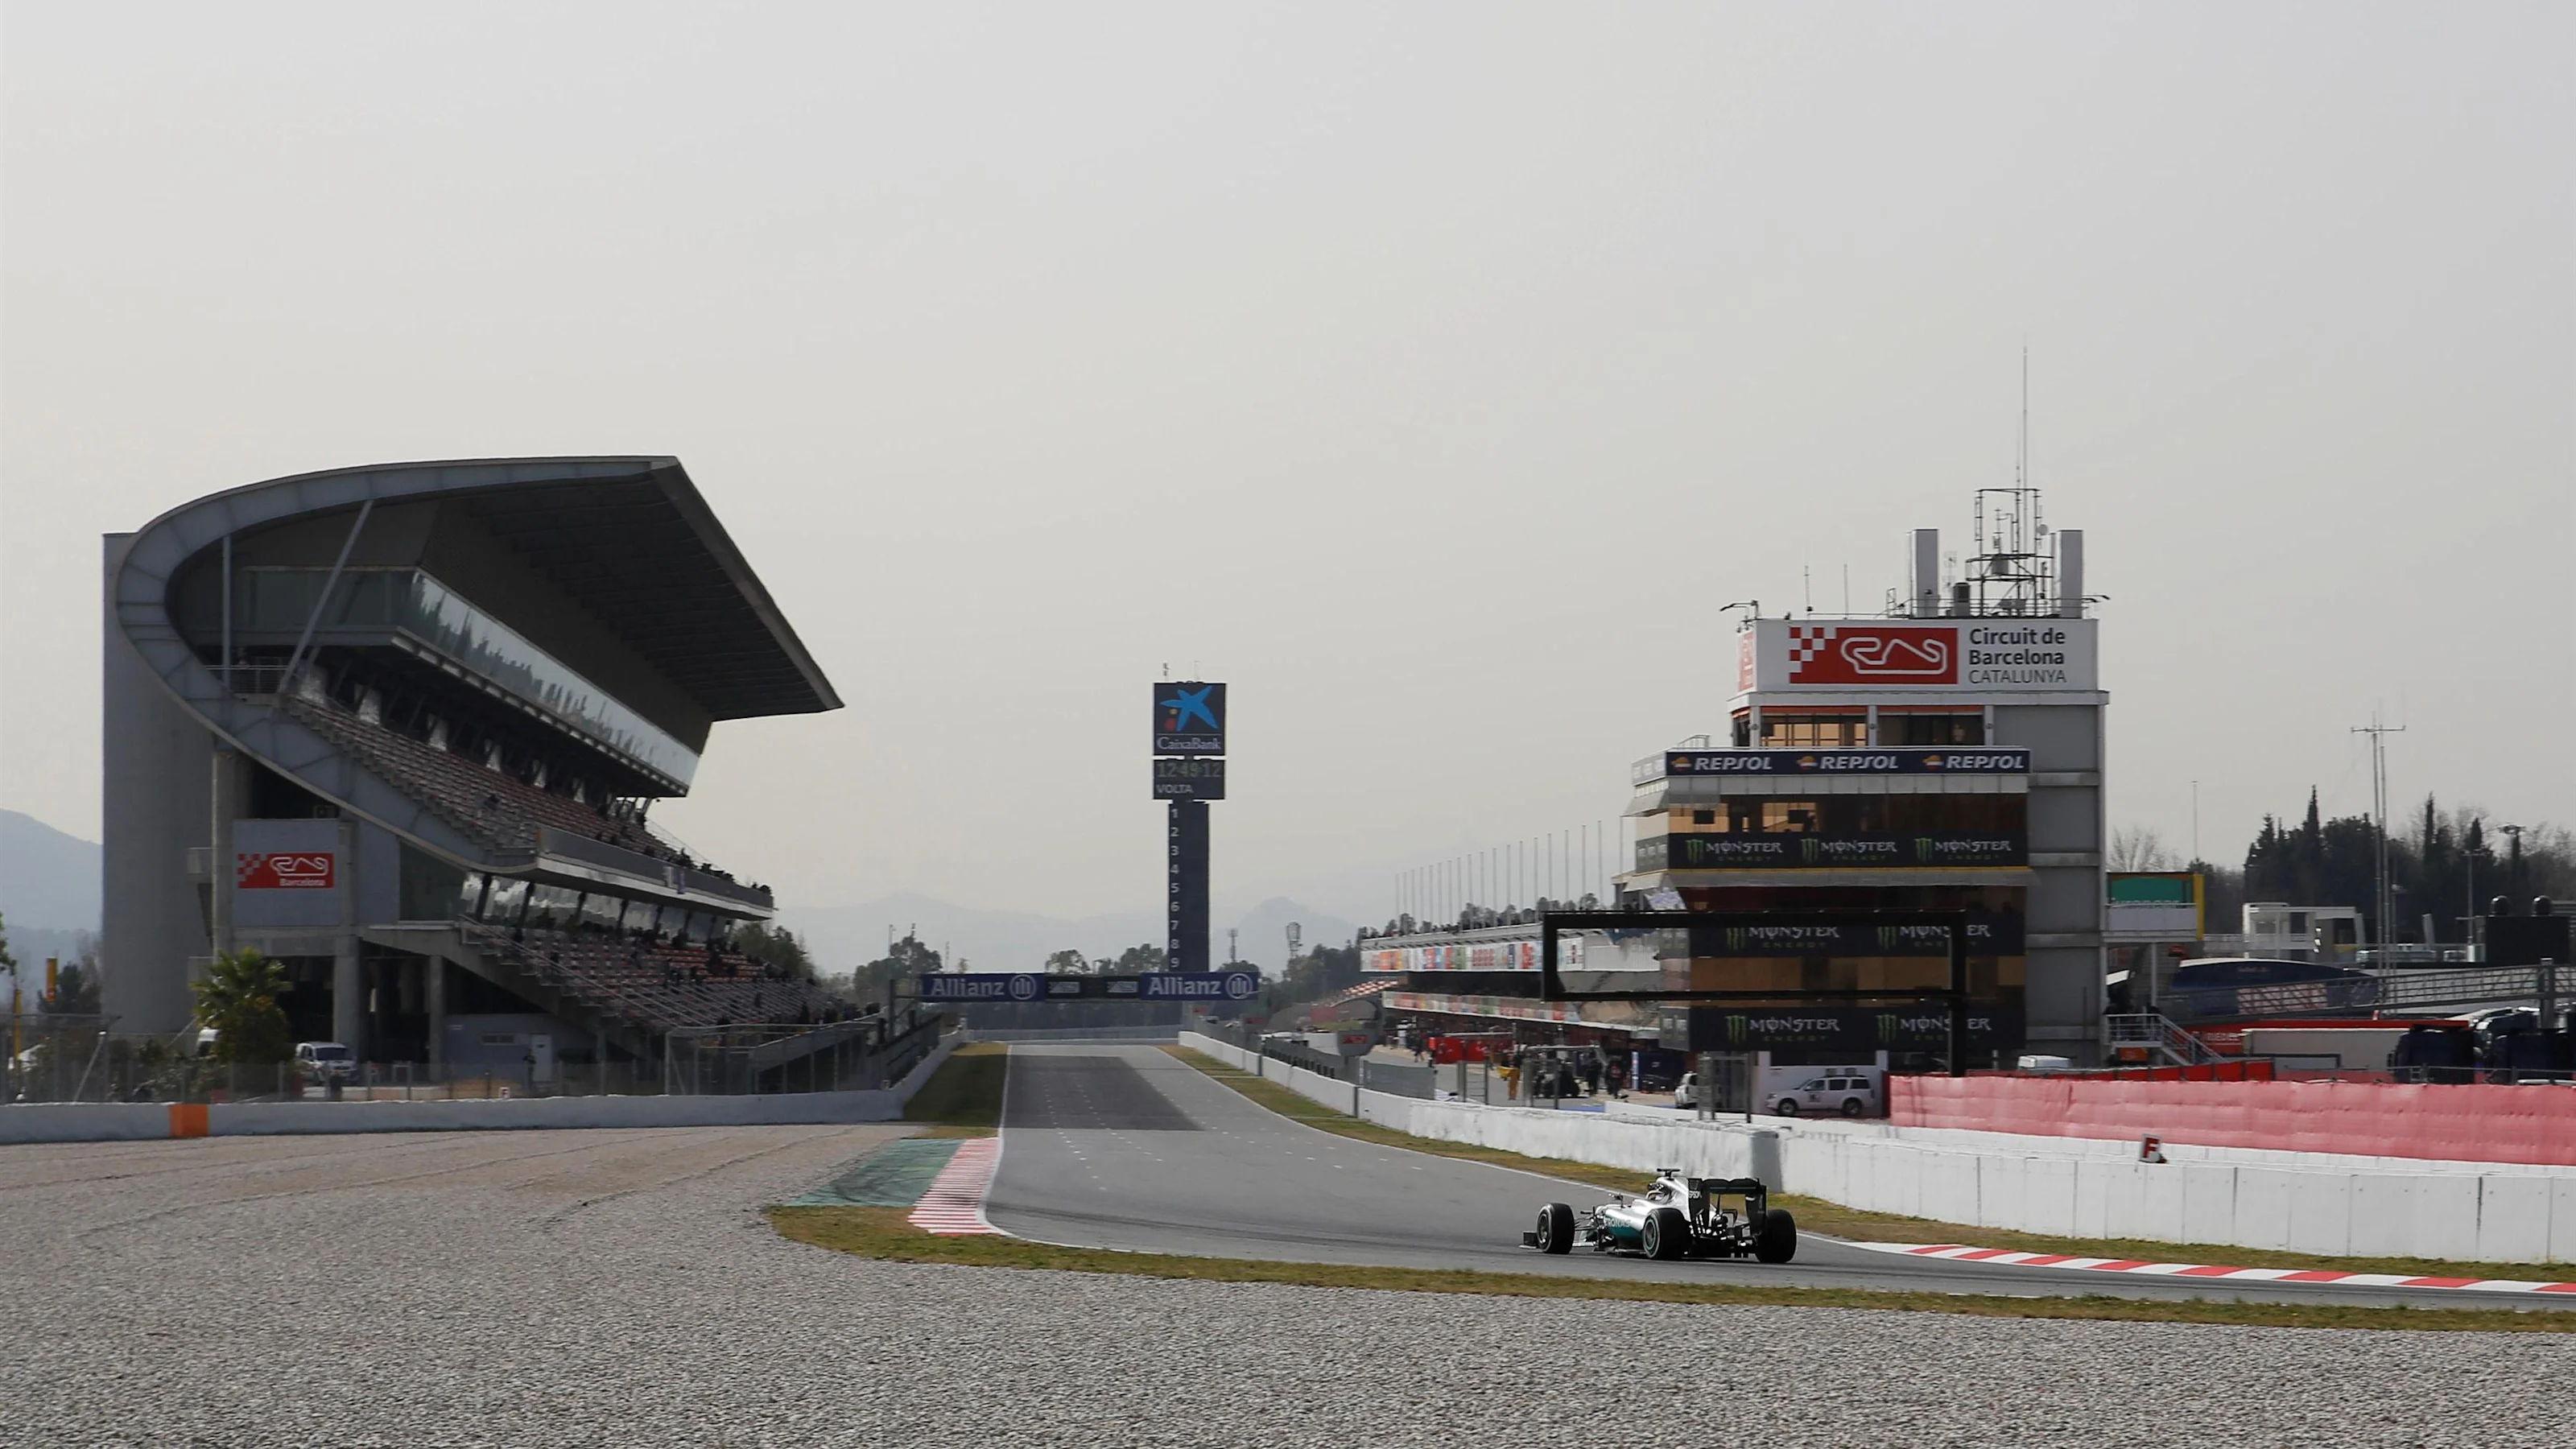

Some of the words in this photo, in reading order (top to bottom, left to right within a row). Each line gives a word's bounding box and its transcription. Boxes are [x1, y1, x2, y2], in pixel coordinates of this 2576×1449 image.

[1969, 627, 2037, 645] Circuit
[2041, 627, 2066, 645] de
[1968, 649, 2065, 666] Barcelona
[1968, 670, 2067, 684] CATALUNYA
[1157, 737, 1221, 750] CaixaBank
[1695, 757, 1773, 770] REPSOL
[1819, 756, 1898, 770] REPSOL
[1946, 755, 2025, 769] REPSOL
[1156, 784, 1194, 794] VOLTA
[1170, 808, 1179, 819] 1
[1170, 827, 1179, 837] 2
[1170, 845, 1179, 856] 3
[1706, 840, 1784, 854] MONSTER
[1820, 840, 1897, 853] MONSTER
[1934, 839, 2012, 852] MONSTER
[1170, 864, 1180, 874] 4
[279, 878, 326, 886] Barcelona
[1170, 882, 1180, 894] 5
[1170, 902, 1180, 912] 6
[1170, 920, 1179, 931] 7
[1900, 925, 1992, 938] MONSER
[1170, 939, 1180, 949] 8
[1170, 957, 1179, 968] 9
[931, 978, 1005, 996] Allianz
[1147, 977, 1222, 995] Allianz
[1749, 1017, 1840, 1033] MONSTER
[1900, 1015, 1992, 1032] MONSER
[2143, 1137, 2159, 1158] F
